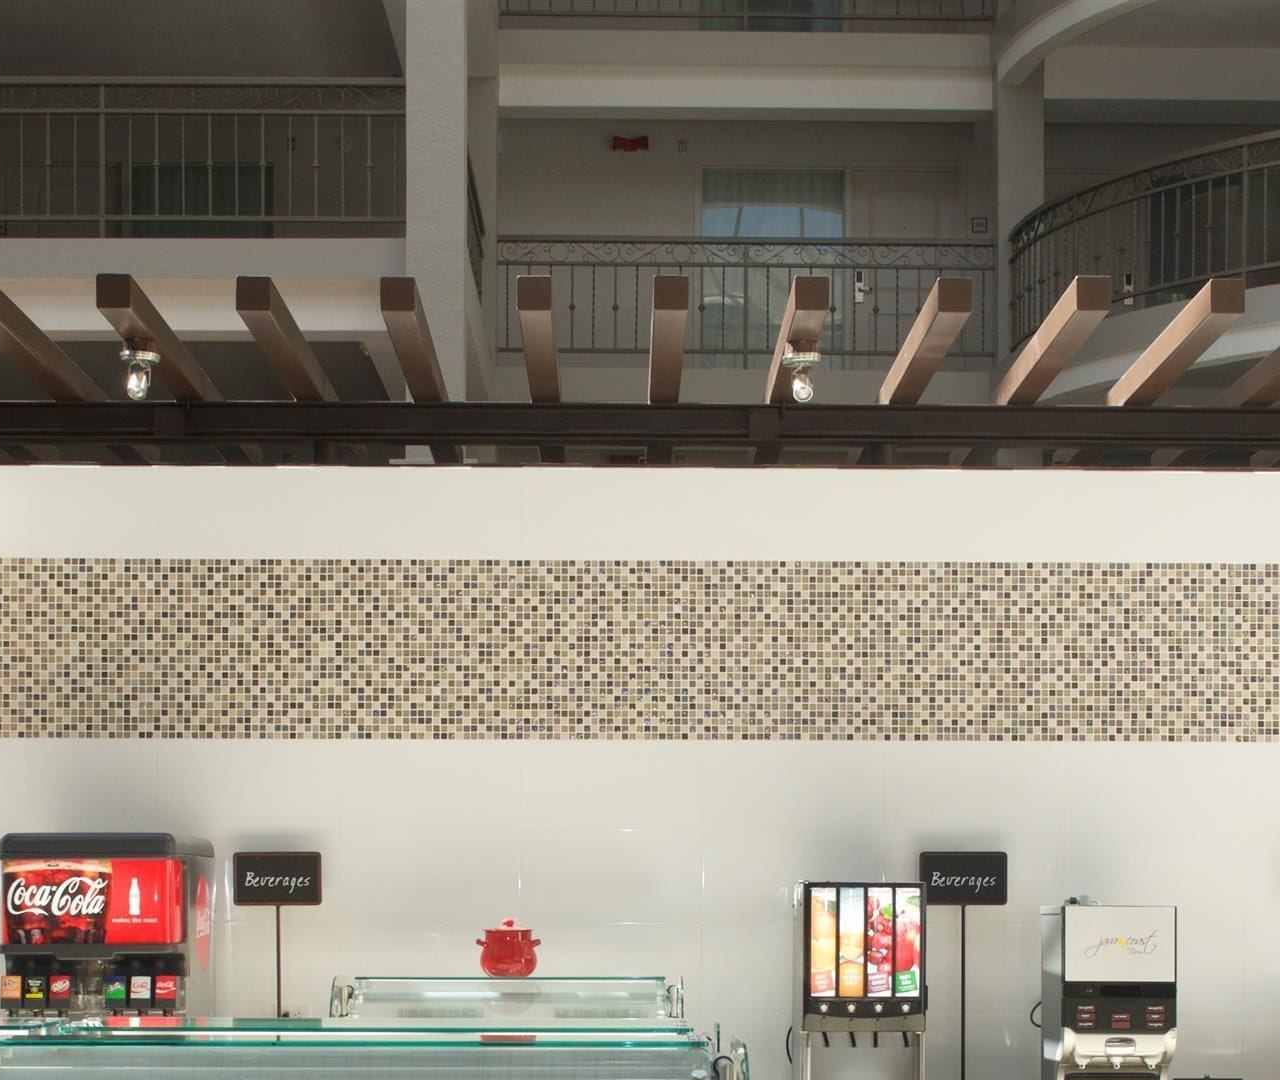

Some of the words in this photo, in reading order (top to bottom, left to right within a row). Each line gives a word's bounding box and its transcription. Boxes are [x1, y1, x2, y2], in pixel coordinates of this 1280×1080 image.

[244, 871, 311, 894] Beverages
[930, 871, 997, 893] Beverages
[6, 876, 108, 916] Coca-Cola
